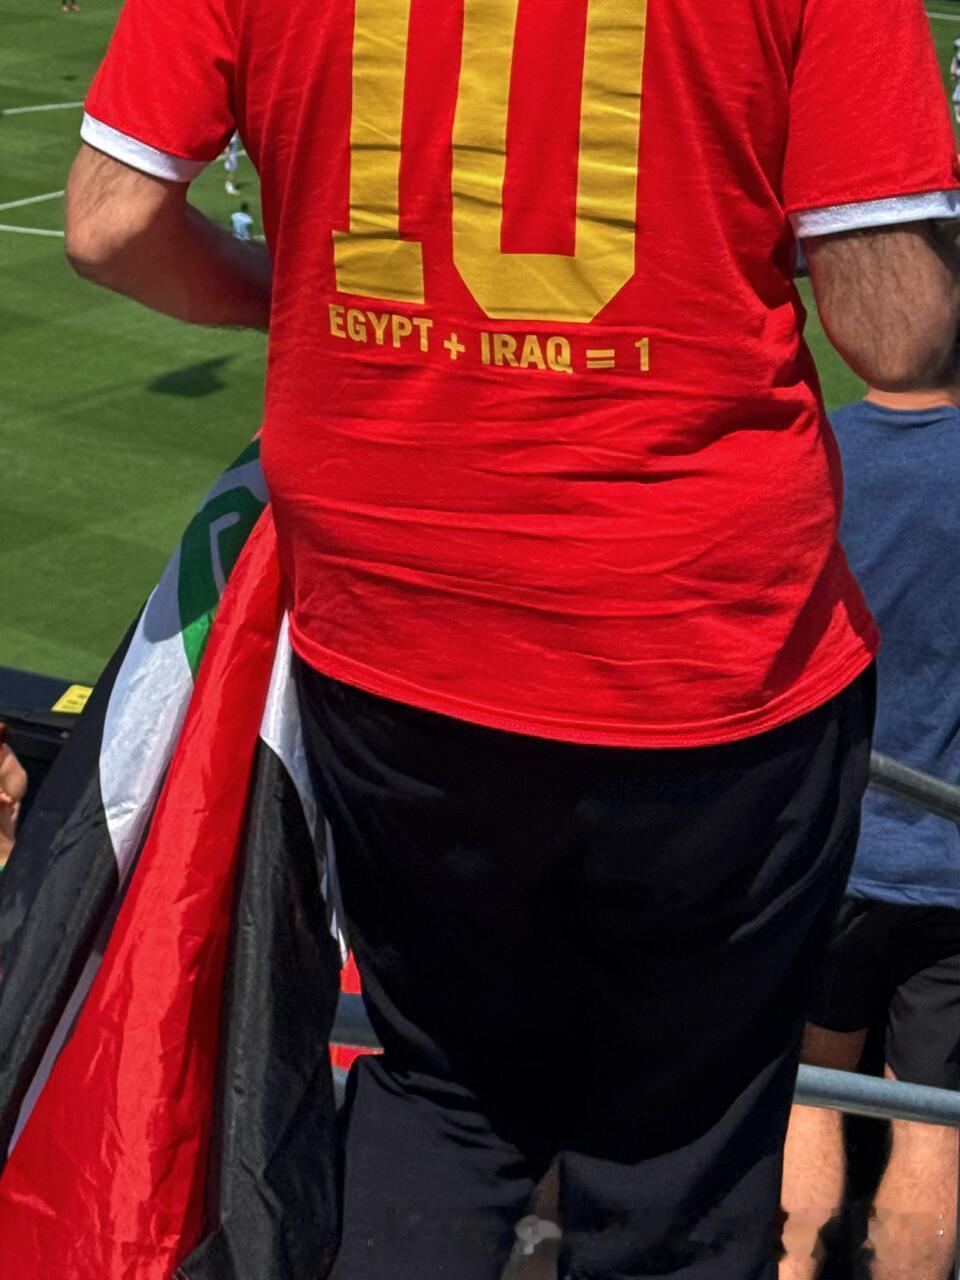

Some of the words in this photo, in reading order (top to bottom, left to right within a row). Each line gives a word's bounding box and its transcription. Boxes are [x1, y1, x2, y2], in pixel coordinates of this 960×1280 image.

[329, 304, 433, 352] EGYPT
[443, 333, 465, 361] +
[481, 332, 573, 375] IRAQ
[586, 348, 615, 370] =
[634, 337, 650, 372] 1
